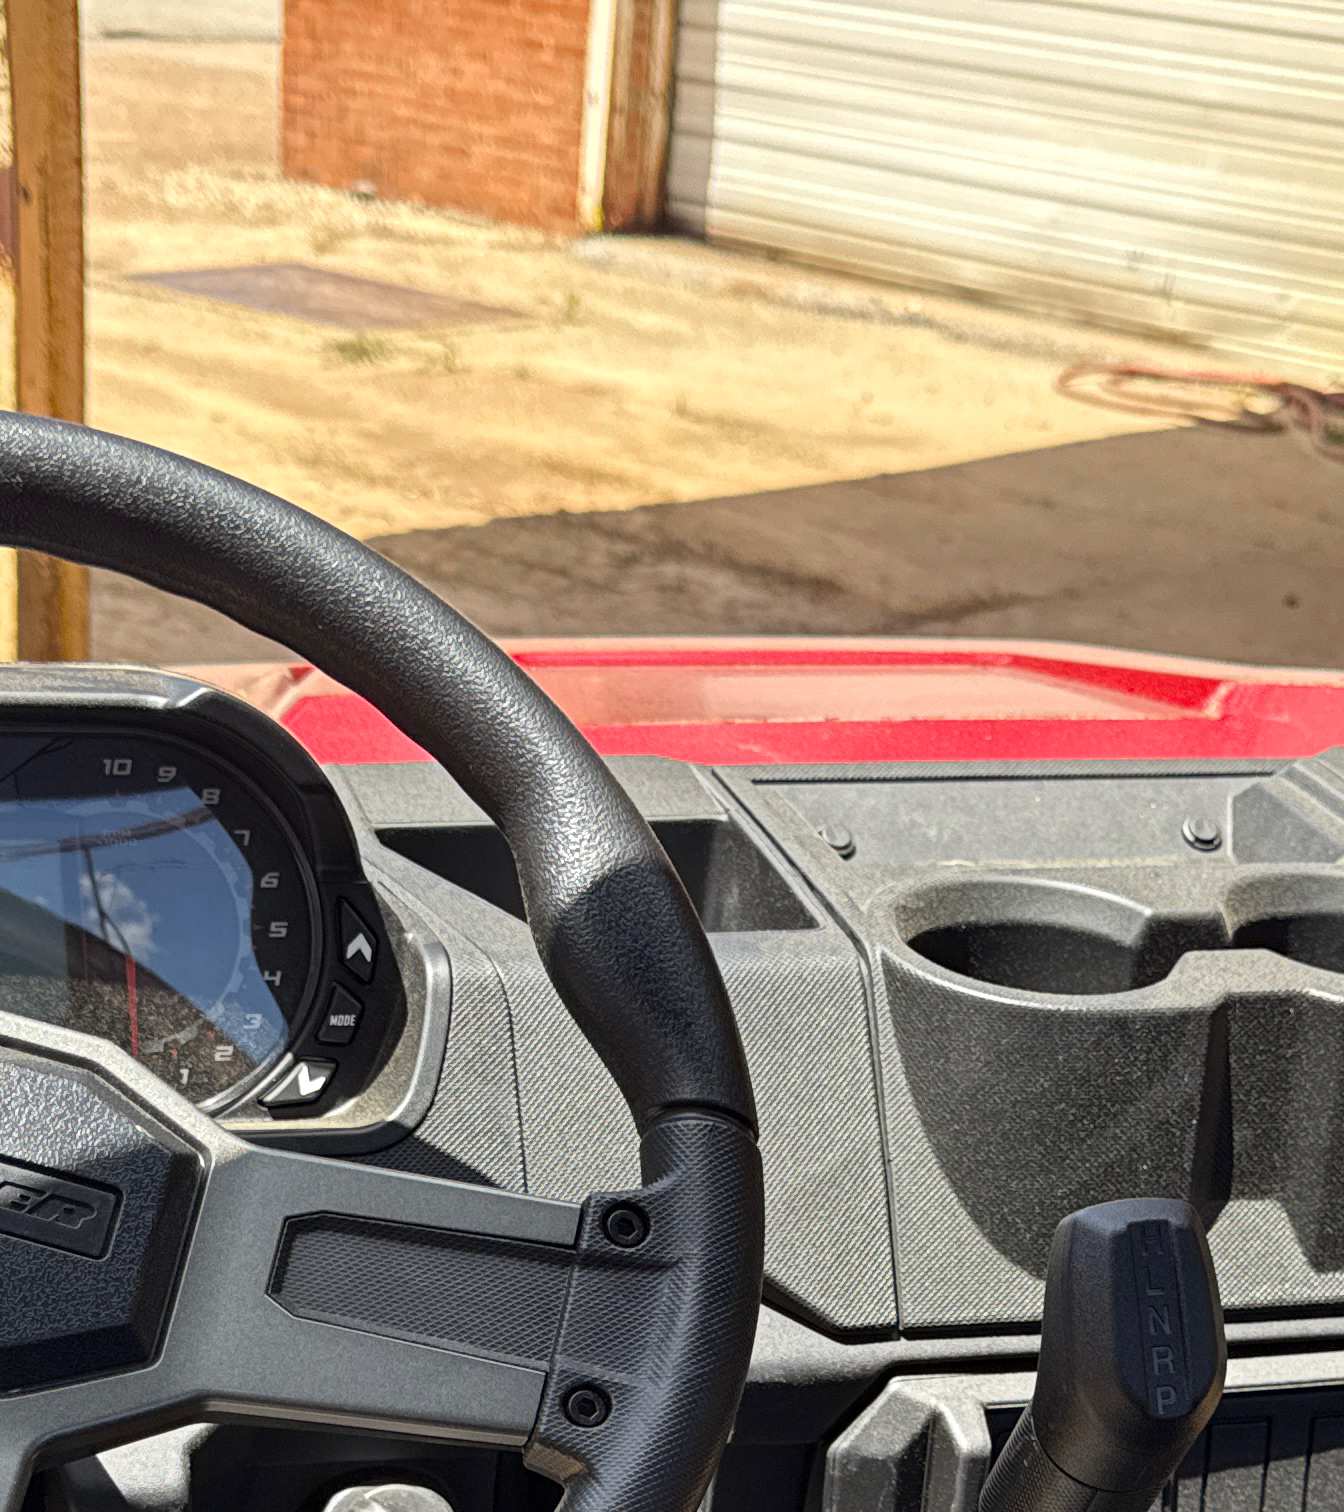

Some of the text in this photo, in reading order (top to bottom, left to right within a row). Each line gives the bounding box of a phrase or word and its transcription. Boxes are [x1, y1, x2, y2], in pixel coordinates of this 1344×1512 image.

[103, 758, 132, 776] 10
[157, 766, 176, 783] 9
[202, 788, 221, 806] 8
[234, 829, 251, 846] 7
[260, 871, 280, 889] 6
[268, 921, 288, 939] 5
[263, 969, 282, 987] 4
[243, 1013, 262, 1030] 3
[329, 1014, 357, 1027] MODE
[214, 1045, 234, 1062] 2
[179, 1068, 190, 1086] 1
[1140, 1225, 1178, 1416] H L N R P
